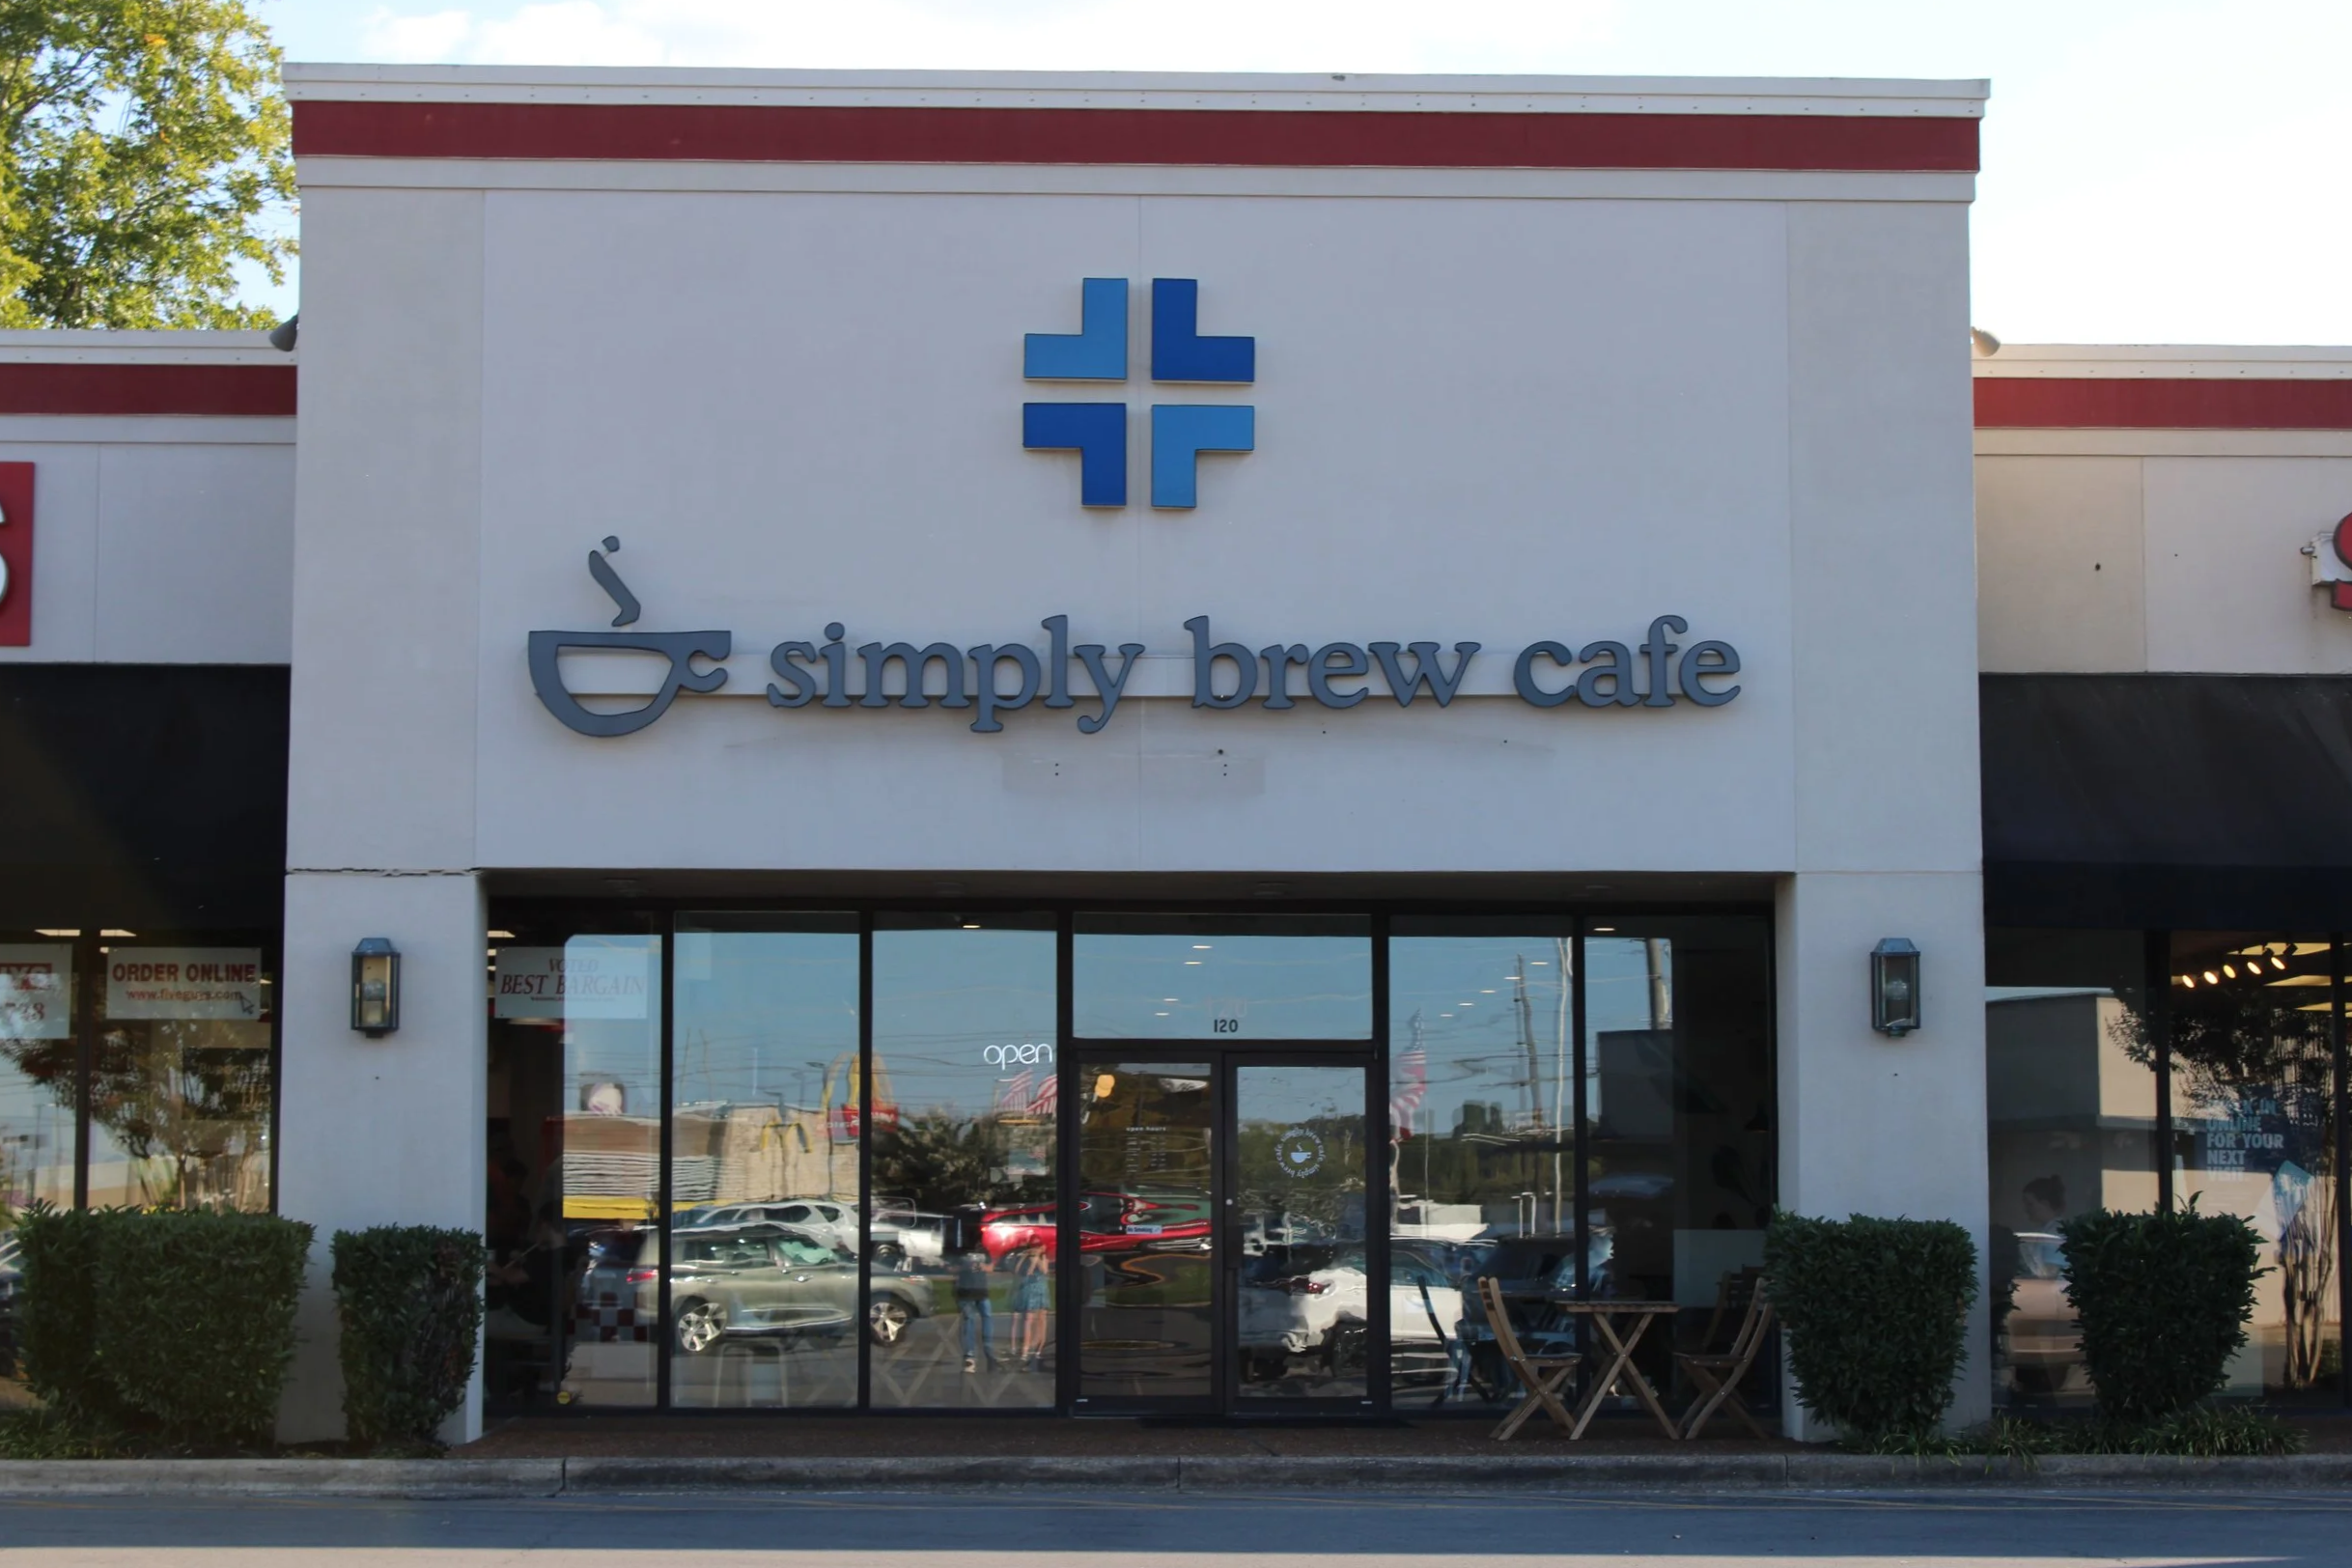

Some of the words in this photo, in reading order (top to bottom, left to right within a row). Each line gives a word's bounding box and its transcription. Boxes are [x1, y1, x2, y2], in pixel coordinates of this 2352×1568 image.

[768, 614, 1145, 734] simply
[1184, 615, 1481, 710] brew
[1513, 614, 1741, 708] cafe
[112, 964, 180, 982] ORDER
[186, 964, 257, 982] ONLINE
[548, 958, 600, 972] VOTED
[500, 974, 549, 995] BEST
[555, 974, 647, 996] BARGAIN
[126, 988, 242, 1002] www.fiveguys.com
[1214, 1019, 1239, 1033] 120
[984, 1043, 1053, 1071] open
[2206, 1116, 2262, 1132] ONLINE
[2206, 1133, 2237, 1148] FOR
[2241, 1133, 2284, 1149] YOUR
[2206, 1150, 2247, 1165] NEXT
